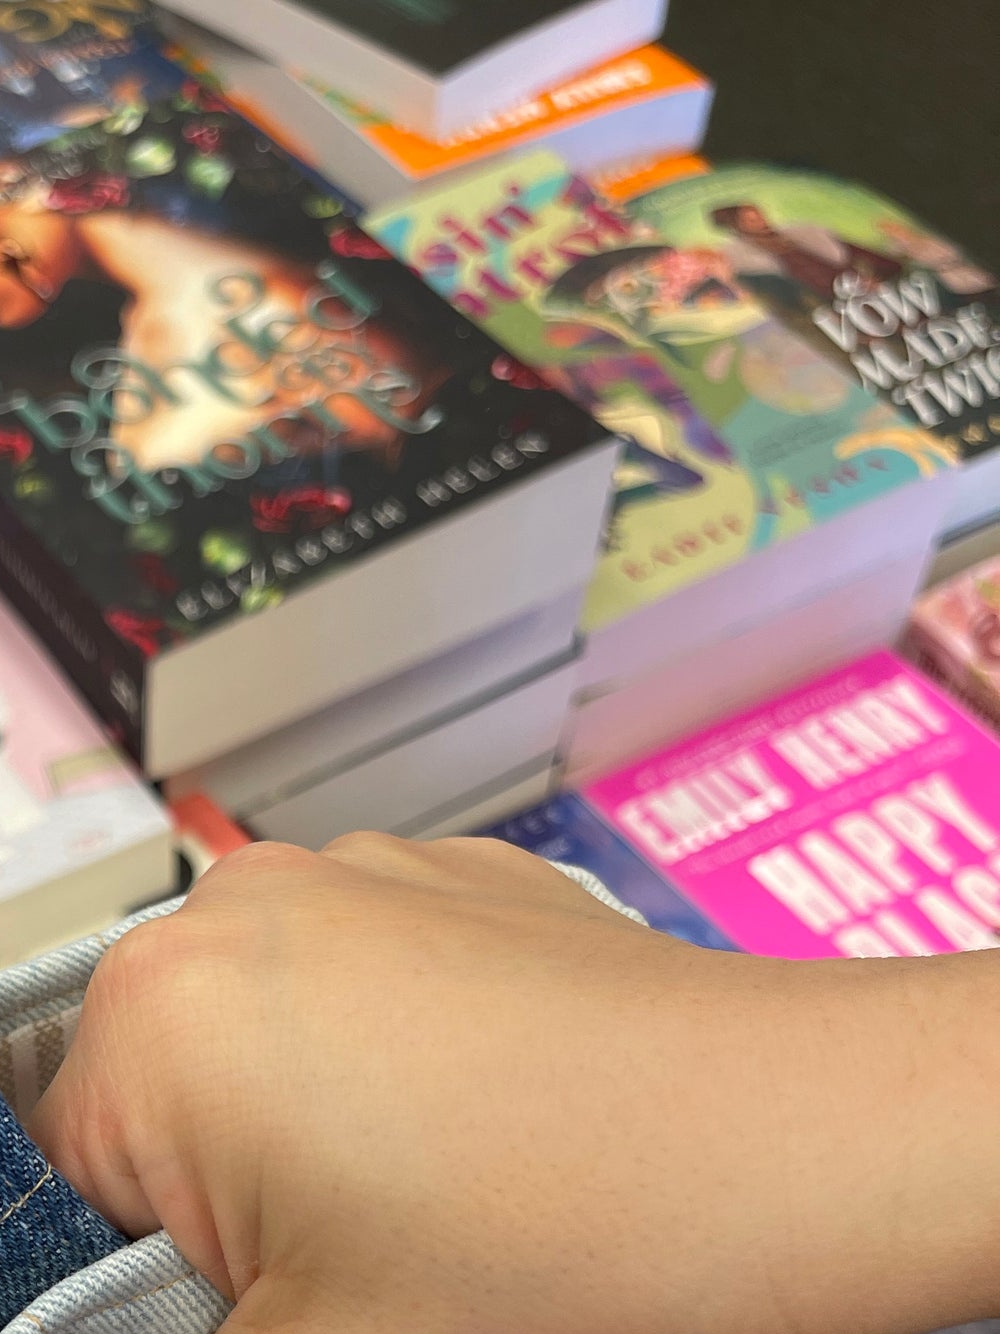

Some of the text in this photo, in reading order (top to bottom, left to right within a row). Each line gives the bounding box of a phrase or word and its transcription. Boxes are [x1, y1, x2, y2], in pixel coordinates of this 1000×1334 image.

[812, 270, 941, 352] VOW
[176, 500, 407, 620] ELIZABETH
[418, 432, 549, 507] HELEN
[617, 750, 791, 865] EMILY
[770, 673, 947, 791] HENRY
[748, 773, 998, 937] HAPPY
